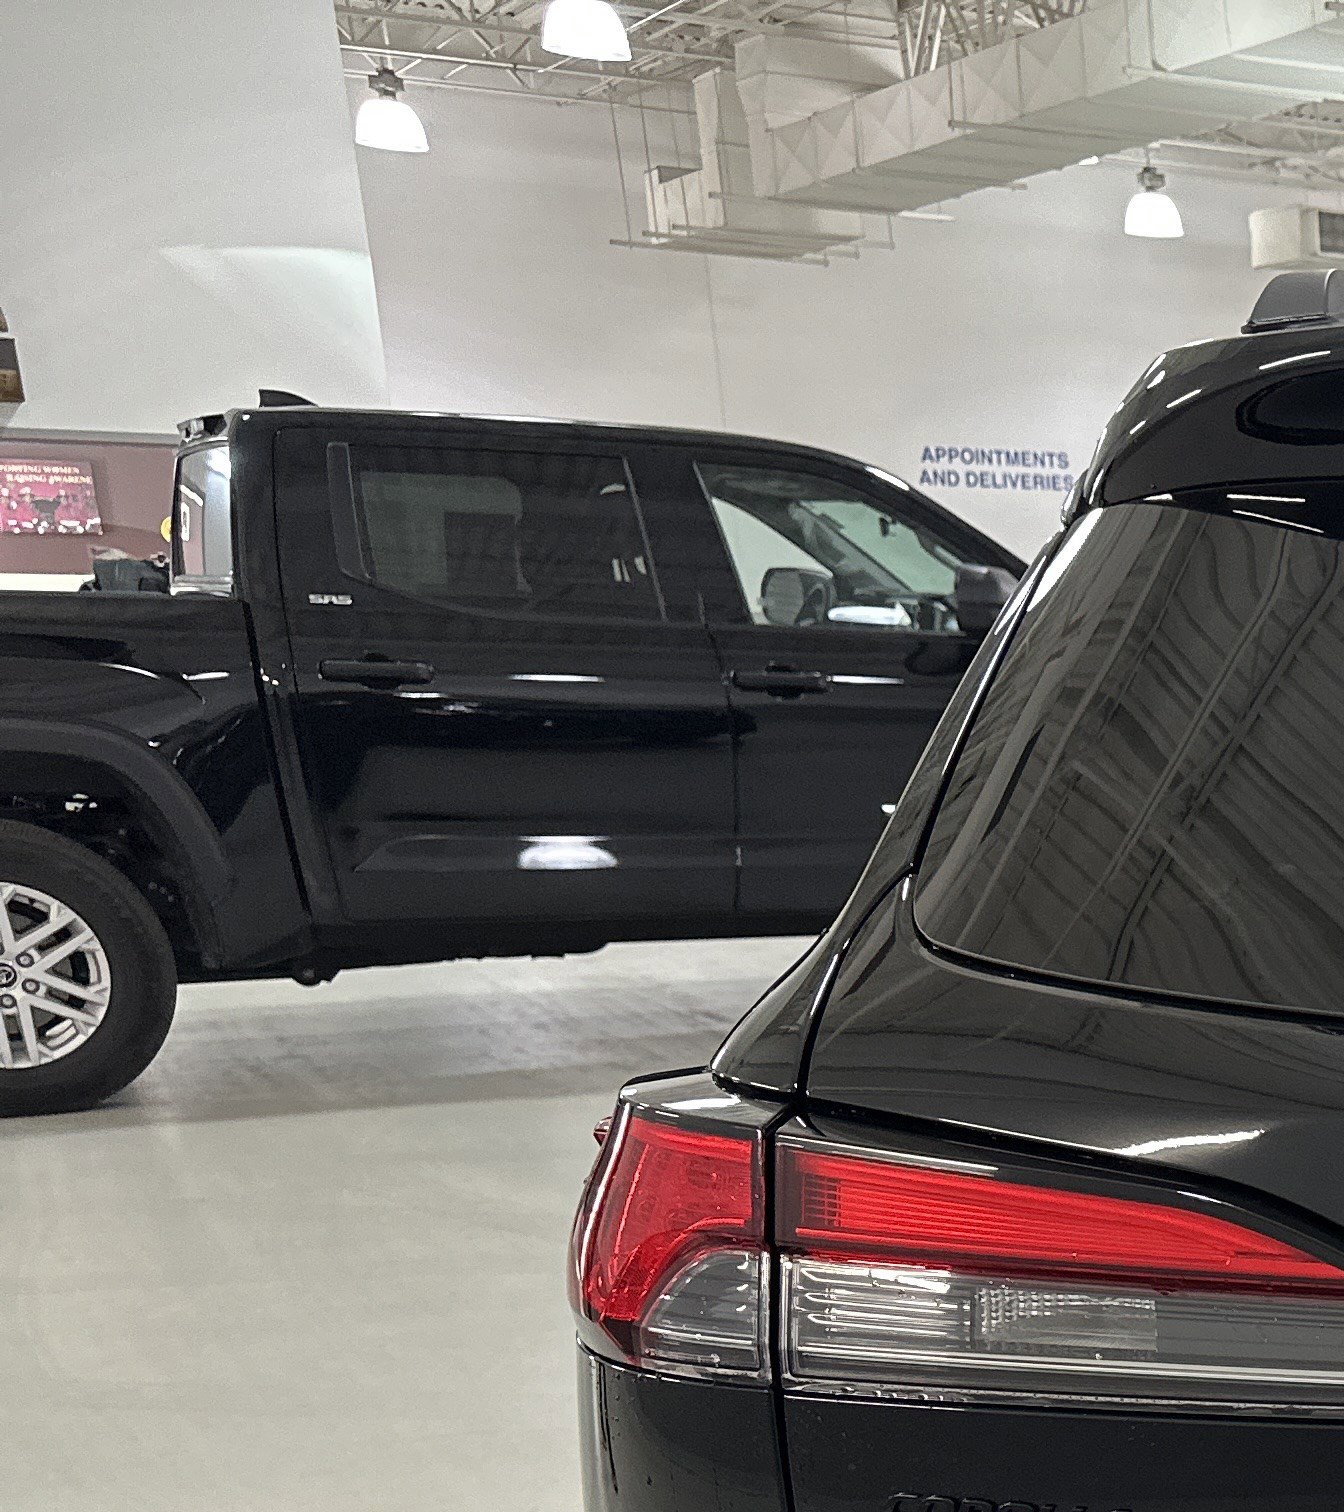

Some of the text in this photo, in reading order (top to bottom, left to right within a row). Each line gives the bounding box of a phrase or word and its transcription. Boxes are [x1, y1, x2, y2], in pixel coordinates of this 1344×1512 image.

[921, 445, 1070, 469] APPOINTMENTS
[919, 469, 1075, 492] AND DELIVERIES
